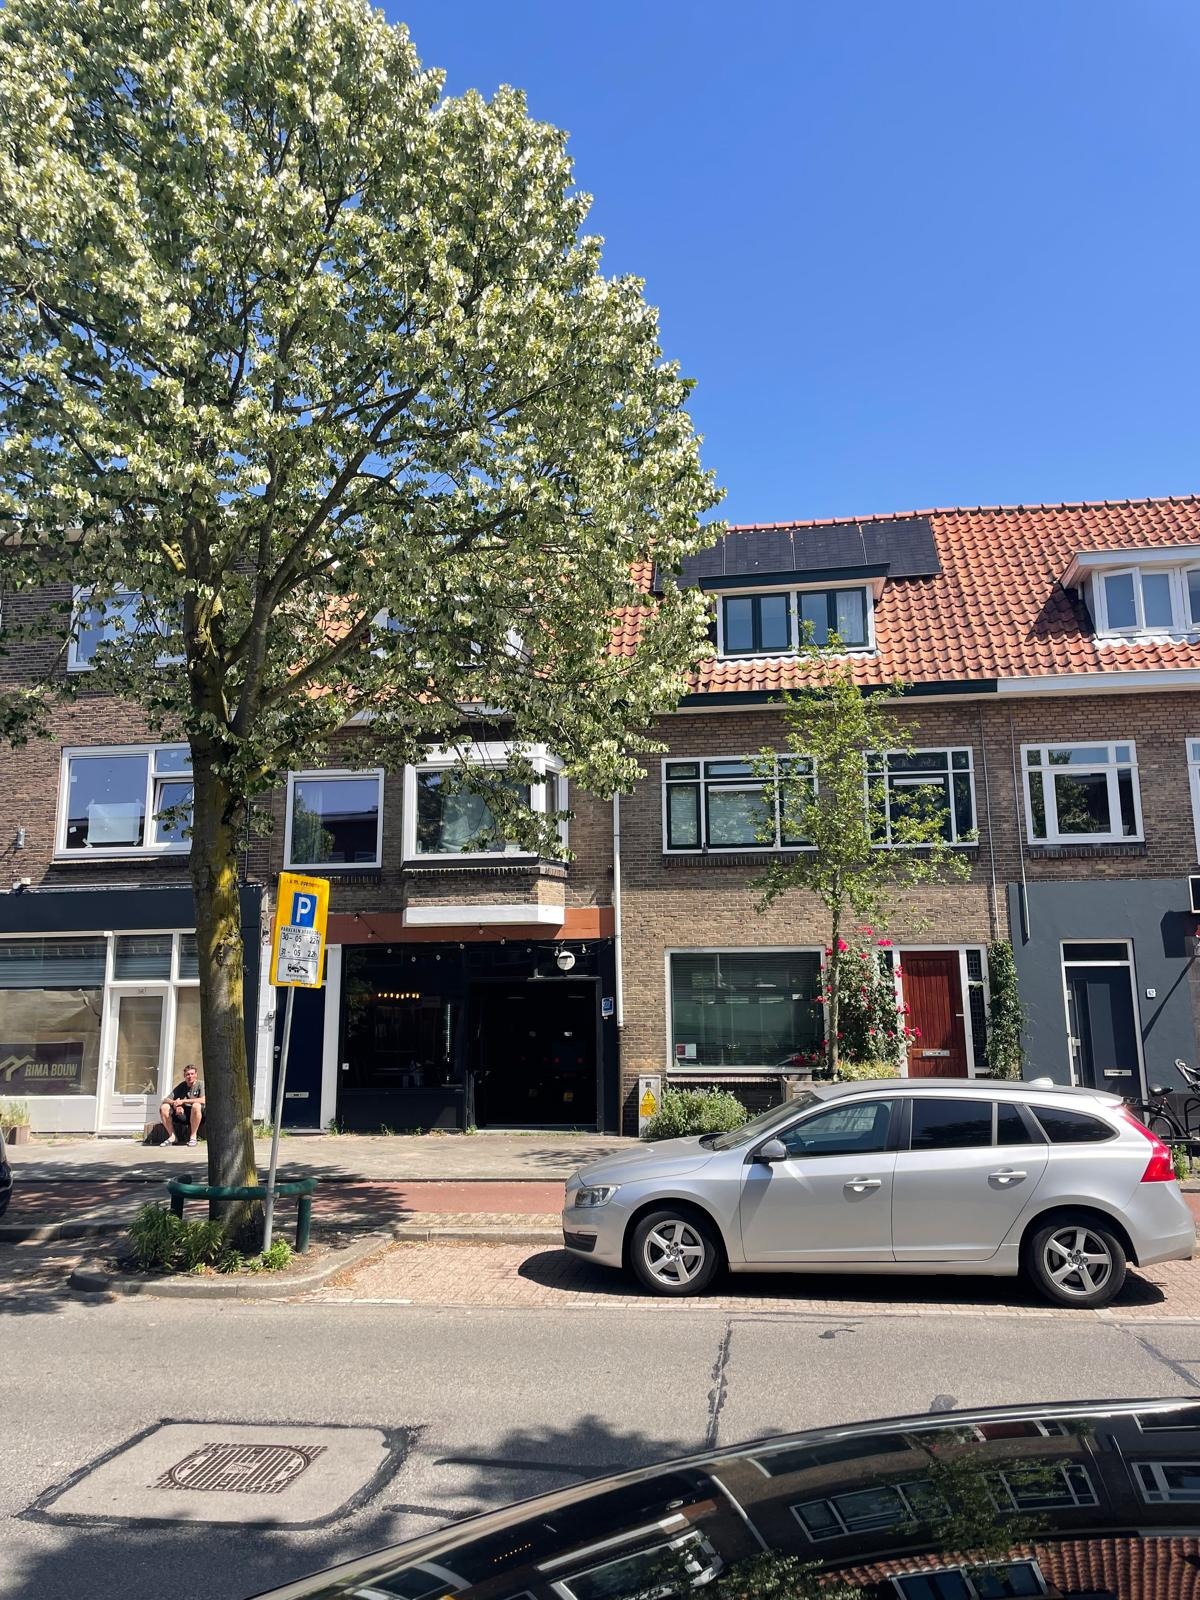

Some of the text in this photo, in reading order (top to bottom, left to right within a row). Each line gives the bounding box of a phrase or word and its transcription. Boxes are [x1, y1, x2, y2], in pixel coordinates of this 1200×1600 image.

[296, 896, 312, 923] P
[24, 1064, 77, 1076] RIMA BOUW
